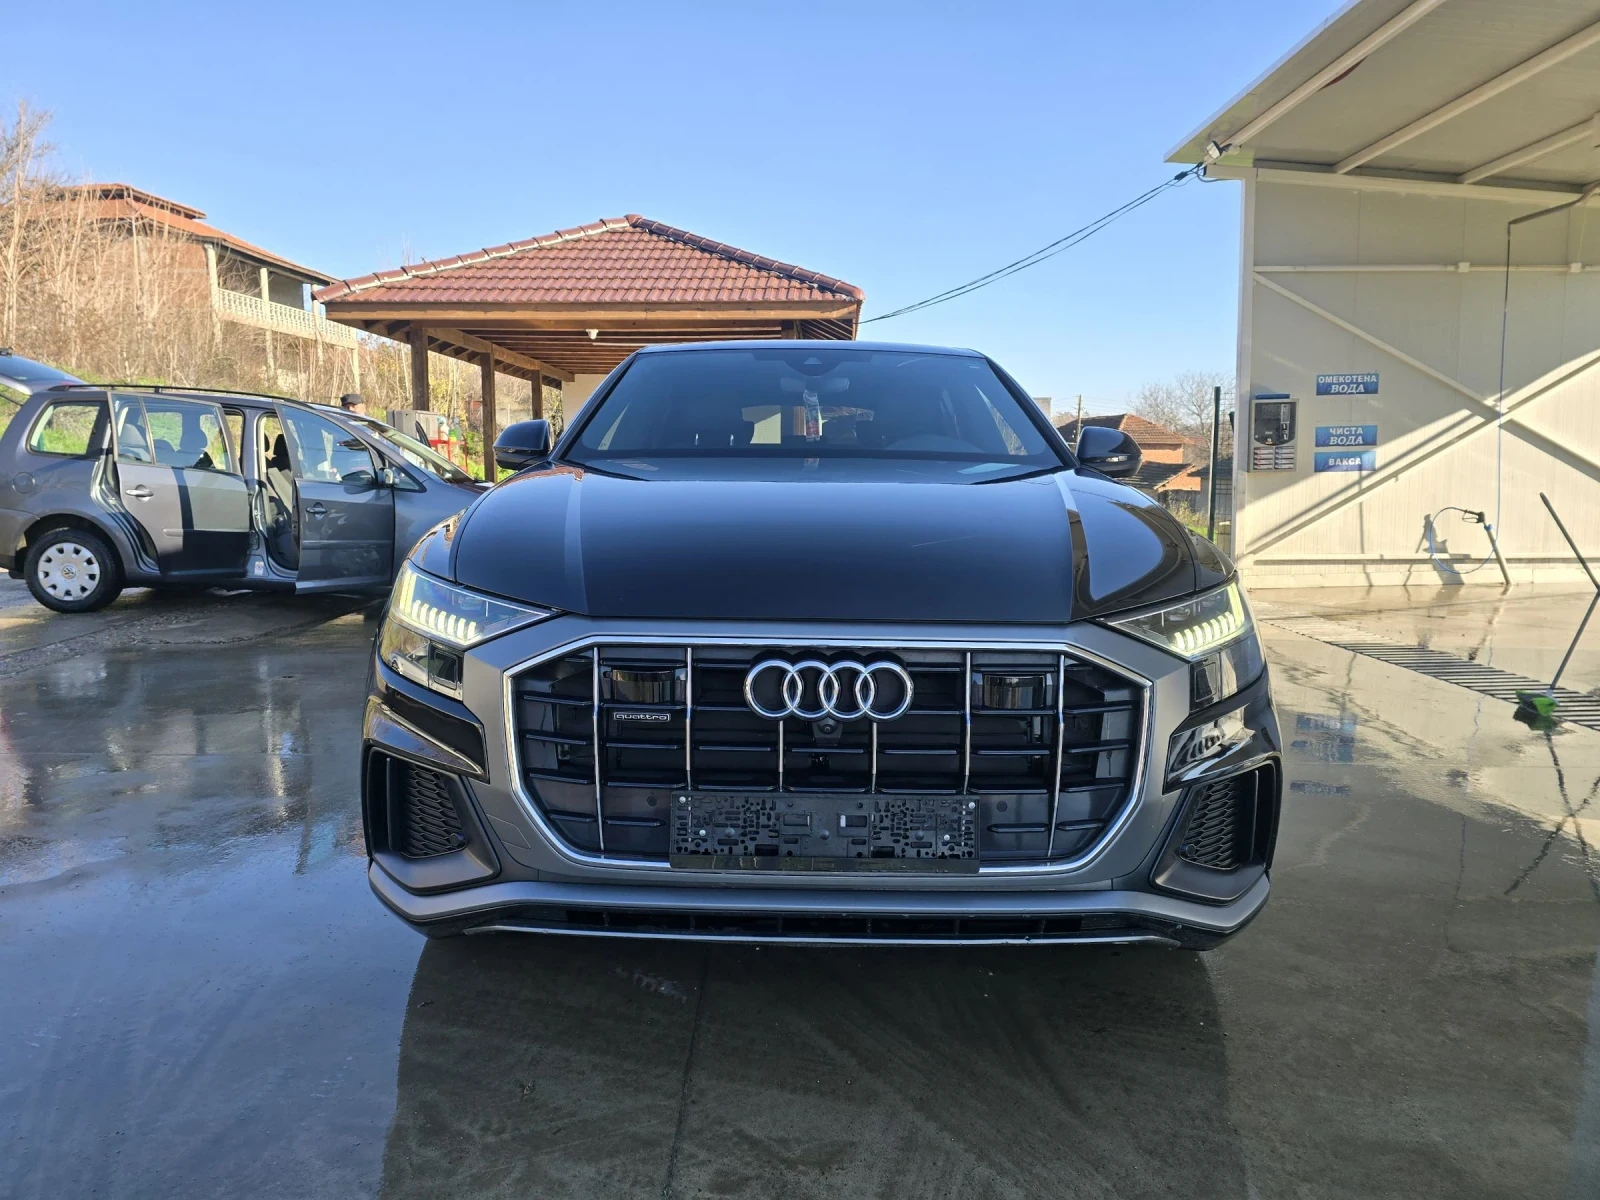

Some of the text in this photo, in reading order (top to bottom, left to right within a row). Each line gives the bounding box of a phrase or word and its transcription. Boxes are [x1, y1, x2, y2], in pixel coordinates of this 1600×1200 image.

[1318, 375, 1377, 383] ОМЕКОТЕНА
[1330, 384, 1365, 393] ВОДА
[1329, 427, 1363, 435] ЧИСТА
[1329, 436, 1363, 445] ВОДА
[1328, 457, 1362, 466] ВАКСА
